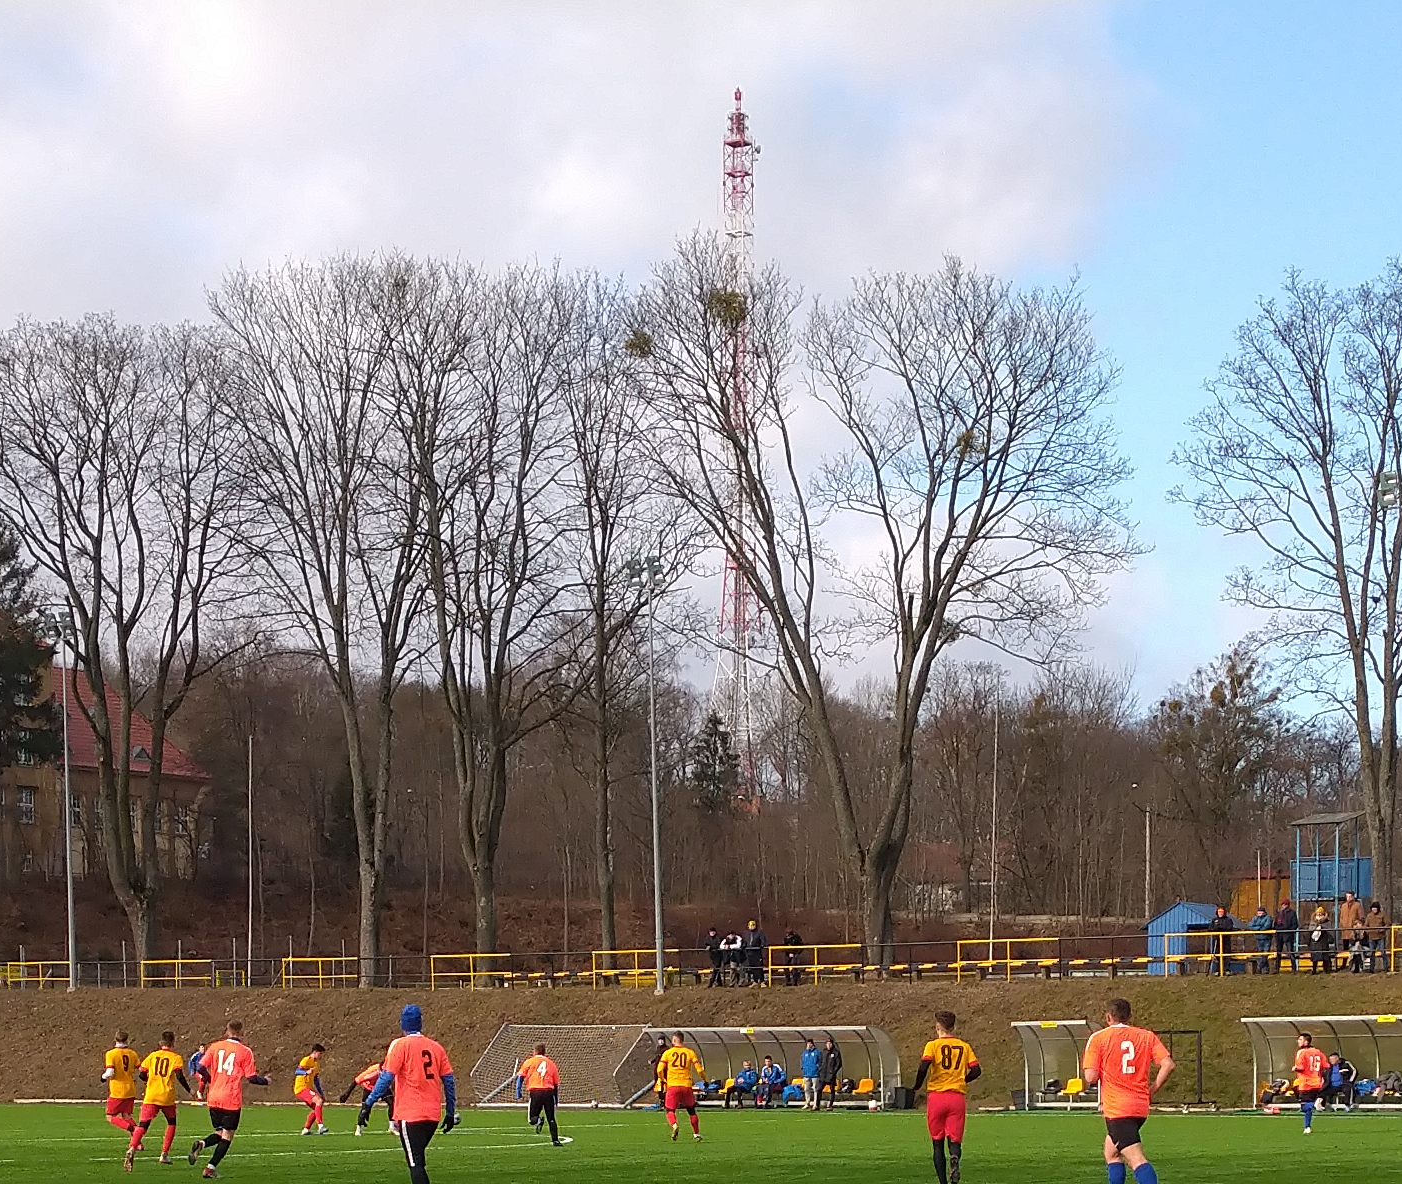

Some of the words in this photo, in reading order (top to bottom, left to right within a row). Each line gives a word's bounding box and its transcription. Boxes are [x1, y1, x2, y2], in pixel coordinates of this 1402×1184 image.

[122, 1055, 129, 1072] 9
[154, 1056, 170, 1077] 10
[217, 1049, 236, 1075] 14
[422, 1050, 434, 1079] 2
[536, 1060, 547, 1077] 4
[671, 1052, 688, 1069] 20
[940, 1044, 964, 1070] 87
[1120, 1040, 1136, 1074] 2
